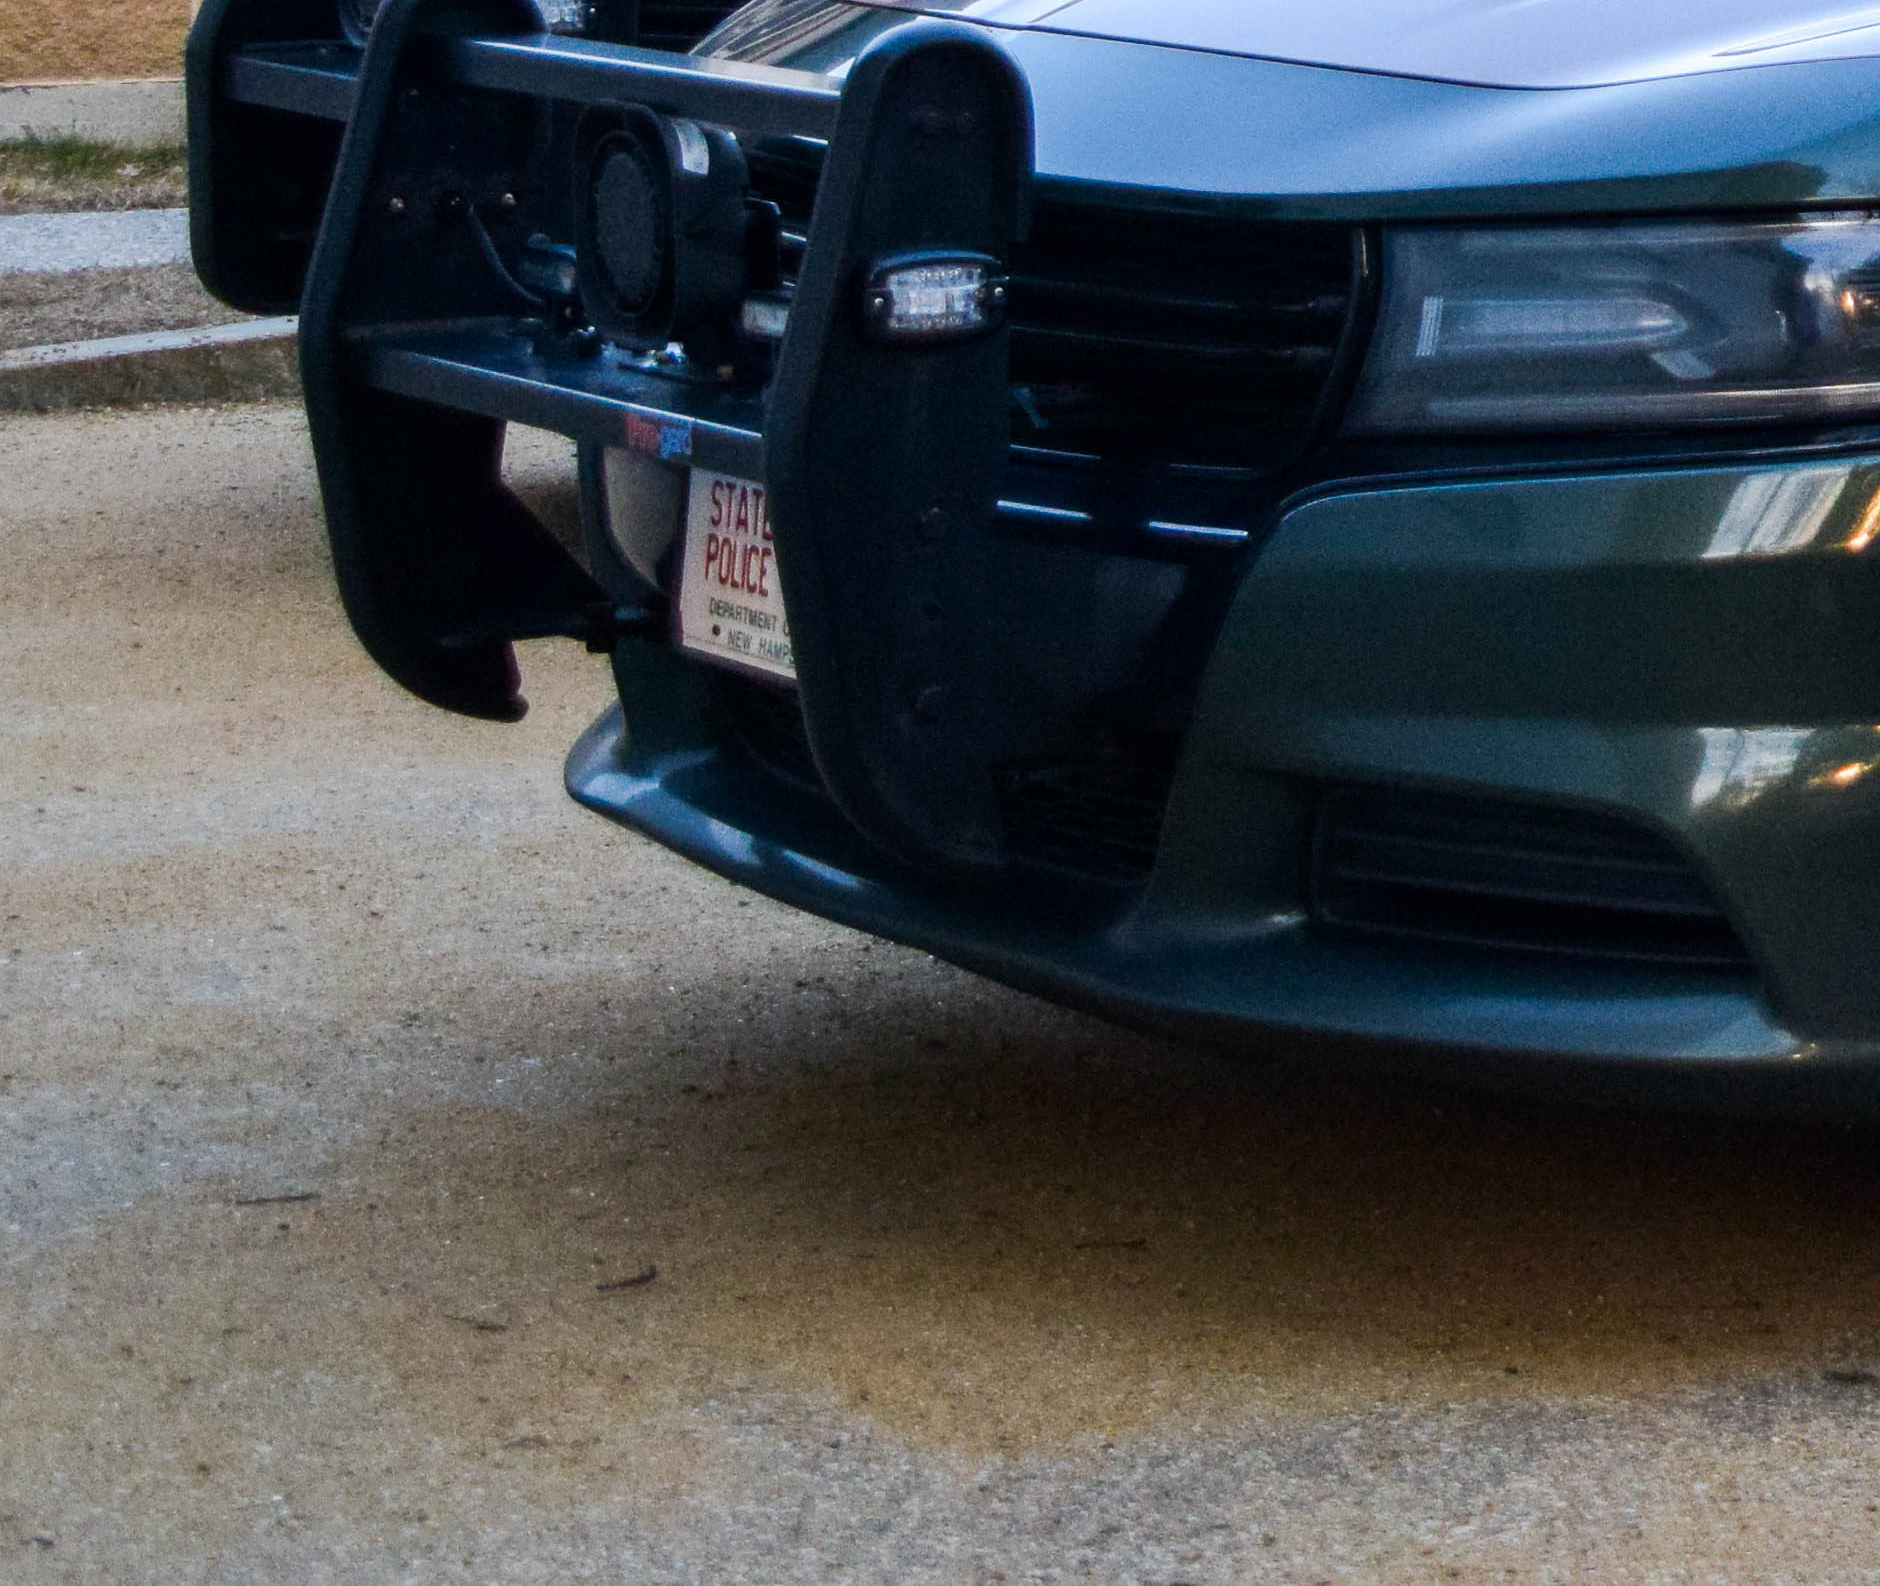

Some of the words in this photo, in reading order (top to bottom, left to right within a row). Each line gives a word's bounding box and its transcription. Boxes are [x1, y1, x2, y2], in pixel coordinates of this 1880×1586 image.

[704, 532, 773, 598] POLICE
[709, 597, 777, 633] DEPARTMENT
[727, 629, 752, 650] NEW
[759, 637, 795, 664] HAMPS
